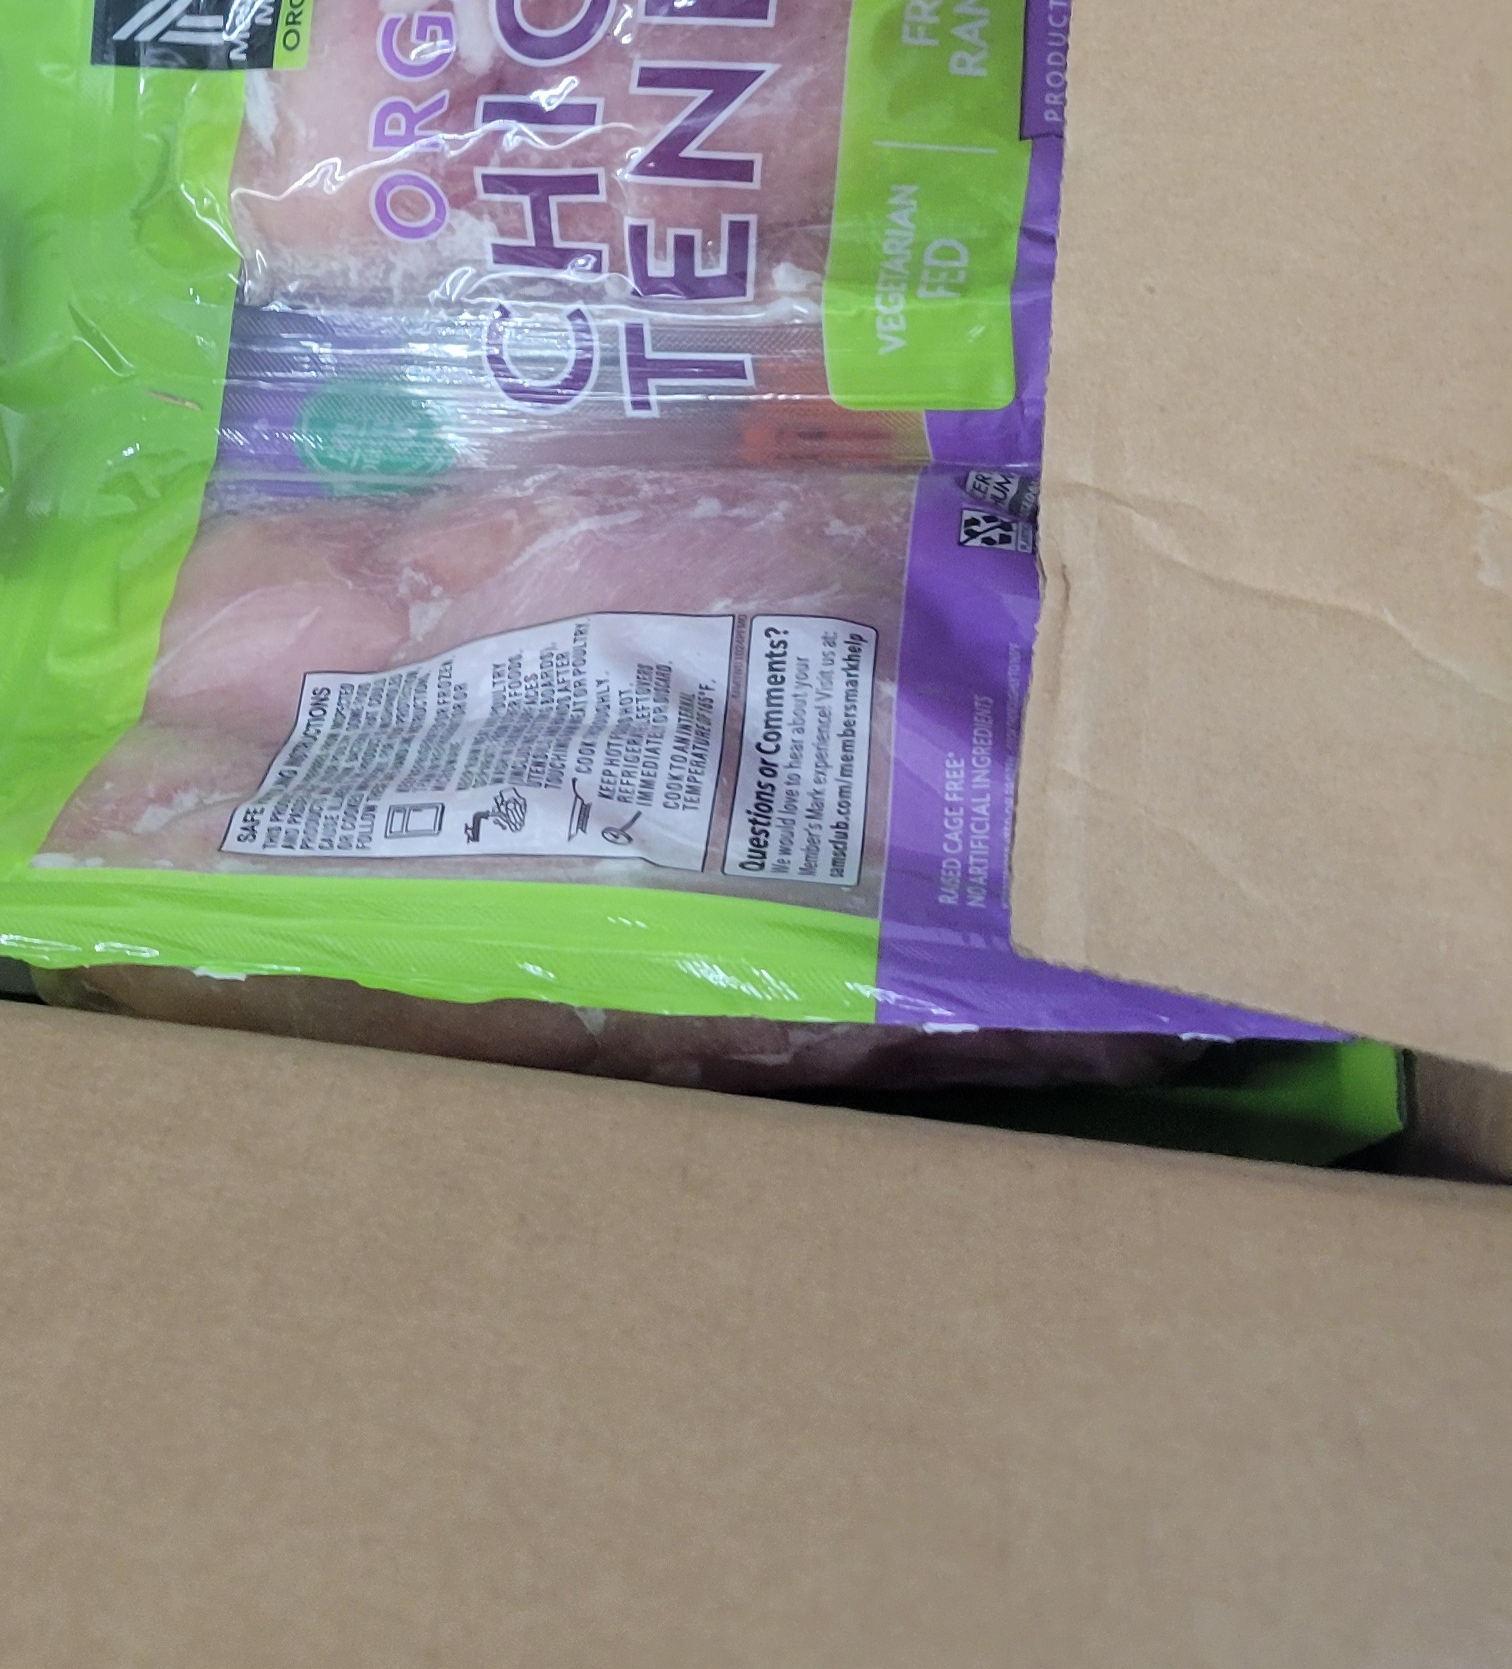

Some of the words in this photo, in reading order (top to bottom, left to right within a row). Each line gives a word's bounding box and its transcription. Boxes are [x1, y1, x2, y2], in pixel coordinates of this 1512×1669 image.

[874, 184, 920, 355] VEGETARIAN
[917, 238, 969, 298] FED
[572, 618, 590, 676] POULTRY.
[820, 631, 838, 649] at:
[820, 650, 835, 667] us
[437, 655, 455, 706] FROZEN.
[508, 649, 523, 697] FOODS.
[556, 651, 571, 693] AFTER
[573, 678, 587, 698] OR
[754, 626, 790, 755] Comments?
[793, 656, 813, 690] your
[815, 670, 835, 702] Visit
[453, 682, 468, 701] OR
[652, 705, 668, 724] OR
[676, 692, 695, 737] INTERNAL
[789, 693, 807, 735] about
[574, 741, 596, 774] COOK
[603, 739, 624, 767] HOT
[672, 735, 692, 752] AN
[783, 738, 804, 769] hear
[811, 706, 834, 786] experience!
[827, 633, 868, 879] samsclub.com/membersmarkhelp
[970, 695, 995, 789] INGREDIENTS
[669, 754, 689, 770] TO
[682, 724, 711, 811] TEMPERATURE
[757, 759, 779, 779] or
[784, 773, 802, 787] to
[597, 769, 615, 800] KEEP
[662, 773, 683, 810] COOK
[781, 789, 799, 816] love
[804, 789, 826, 821] Mark
[236, 807, 265, 843] SAFE
[355, 805, 378, 850] FOLLOW
[737, 780, 777, 872] Questions
[773, 818, 797, 856] would
[942, 807, 963, 853] CAGE
[967, 793, 991, 886] ARTIFICIAL
[770, 858, 792, 873] We
[797, 822, 823, 877] Member's
[938, 857, 961, 905] RAISED
[967, 886, 987, 908] NO
